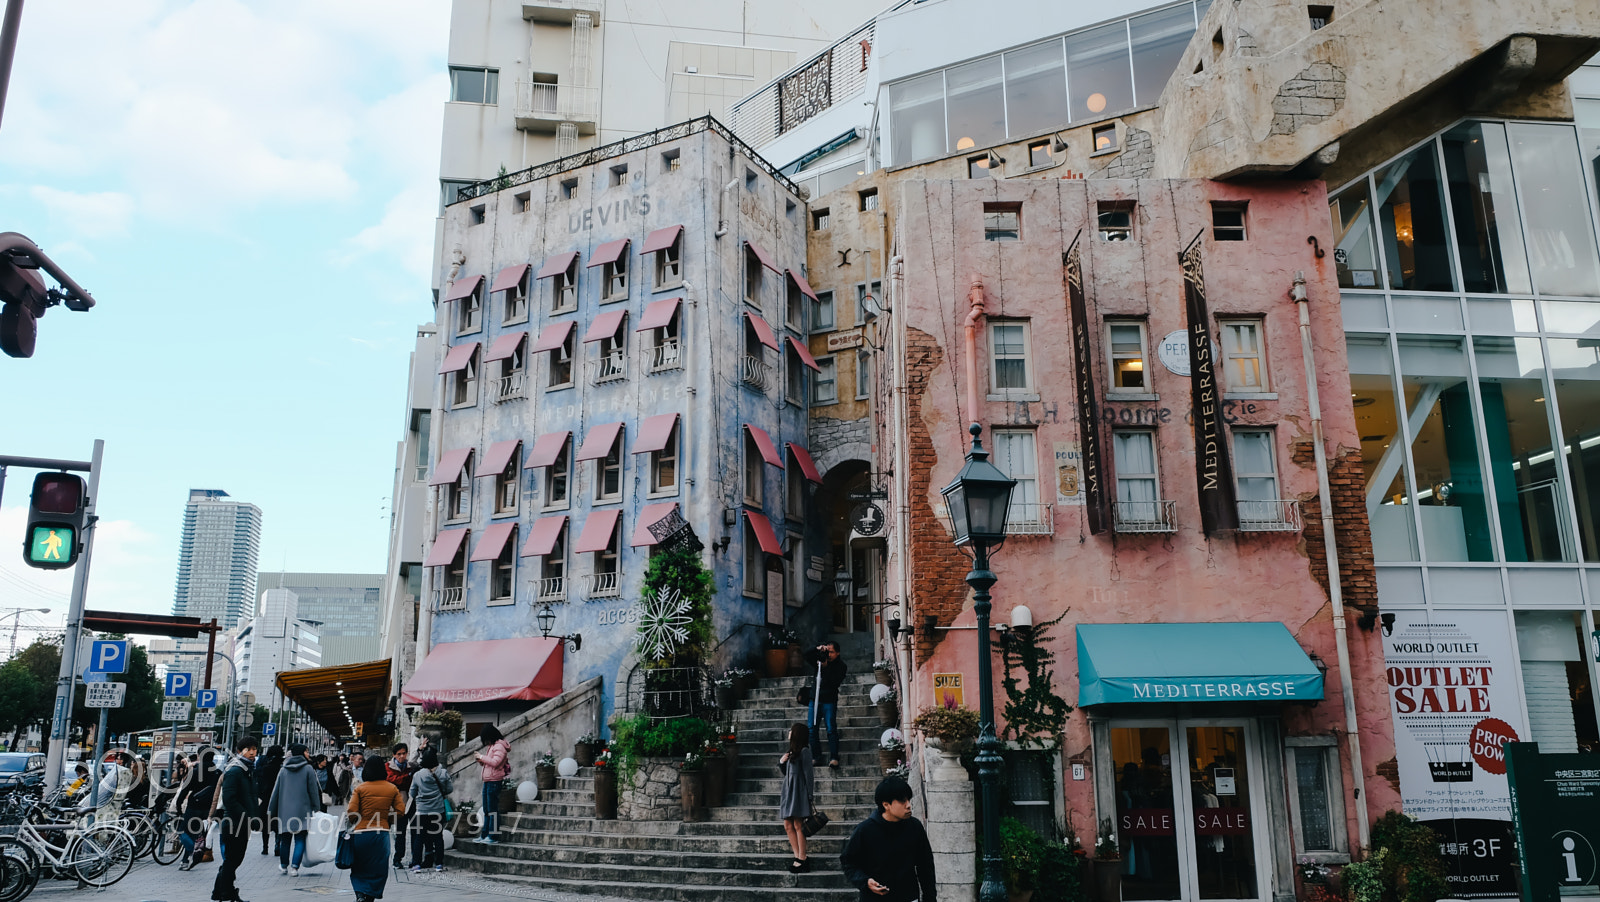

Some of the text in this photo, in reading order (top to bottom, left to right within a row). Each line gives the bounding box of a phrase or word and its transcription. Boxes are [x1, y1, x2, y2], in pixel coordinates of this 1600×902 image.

[1392, 642, 1479, 653] WORLD OUTLET
[99, 643, 120, 670] P
[170, 674, 187, 695] P
[935, 675, 961, 688] SUZE
[1386, 666, 1493, 687] OUTLET
[1132, 682, 1296, 699] MEDITERRASSE
[201, 691, 214, 707] P
[1394, 686, 1491, 714] SALE
[265, 724, 274, 734] P
[1473, 742, 1505, 762] DOW
[1123, 815, 1171, 829] SALE
[1198, 814, 1245, 829] SALE
[1472, 838, 1501, 858] 3F
[1469, 874, 1500, 882] OUTLET
